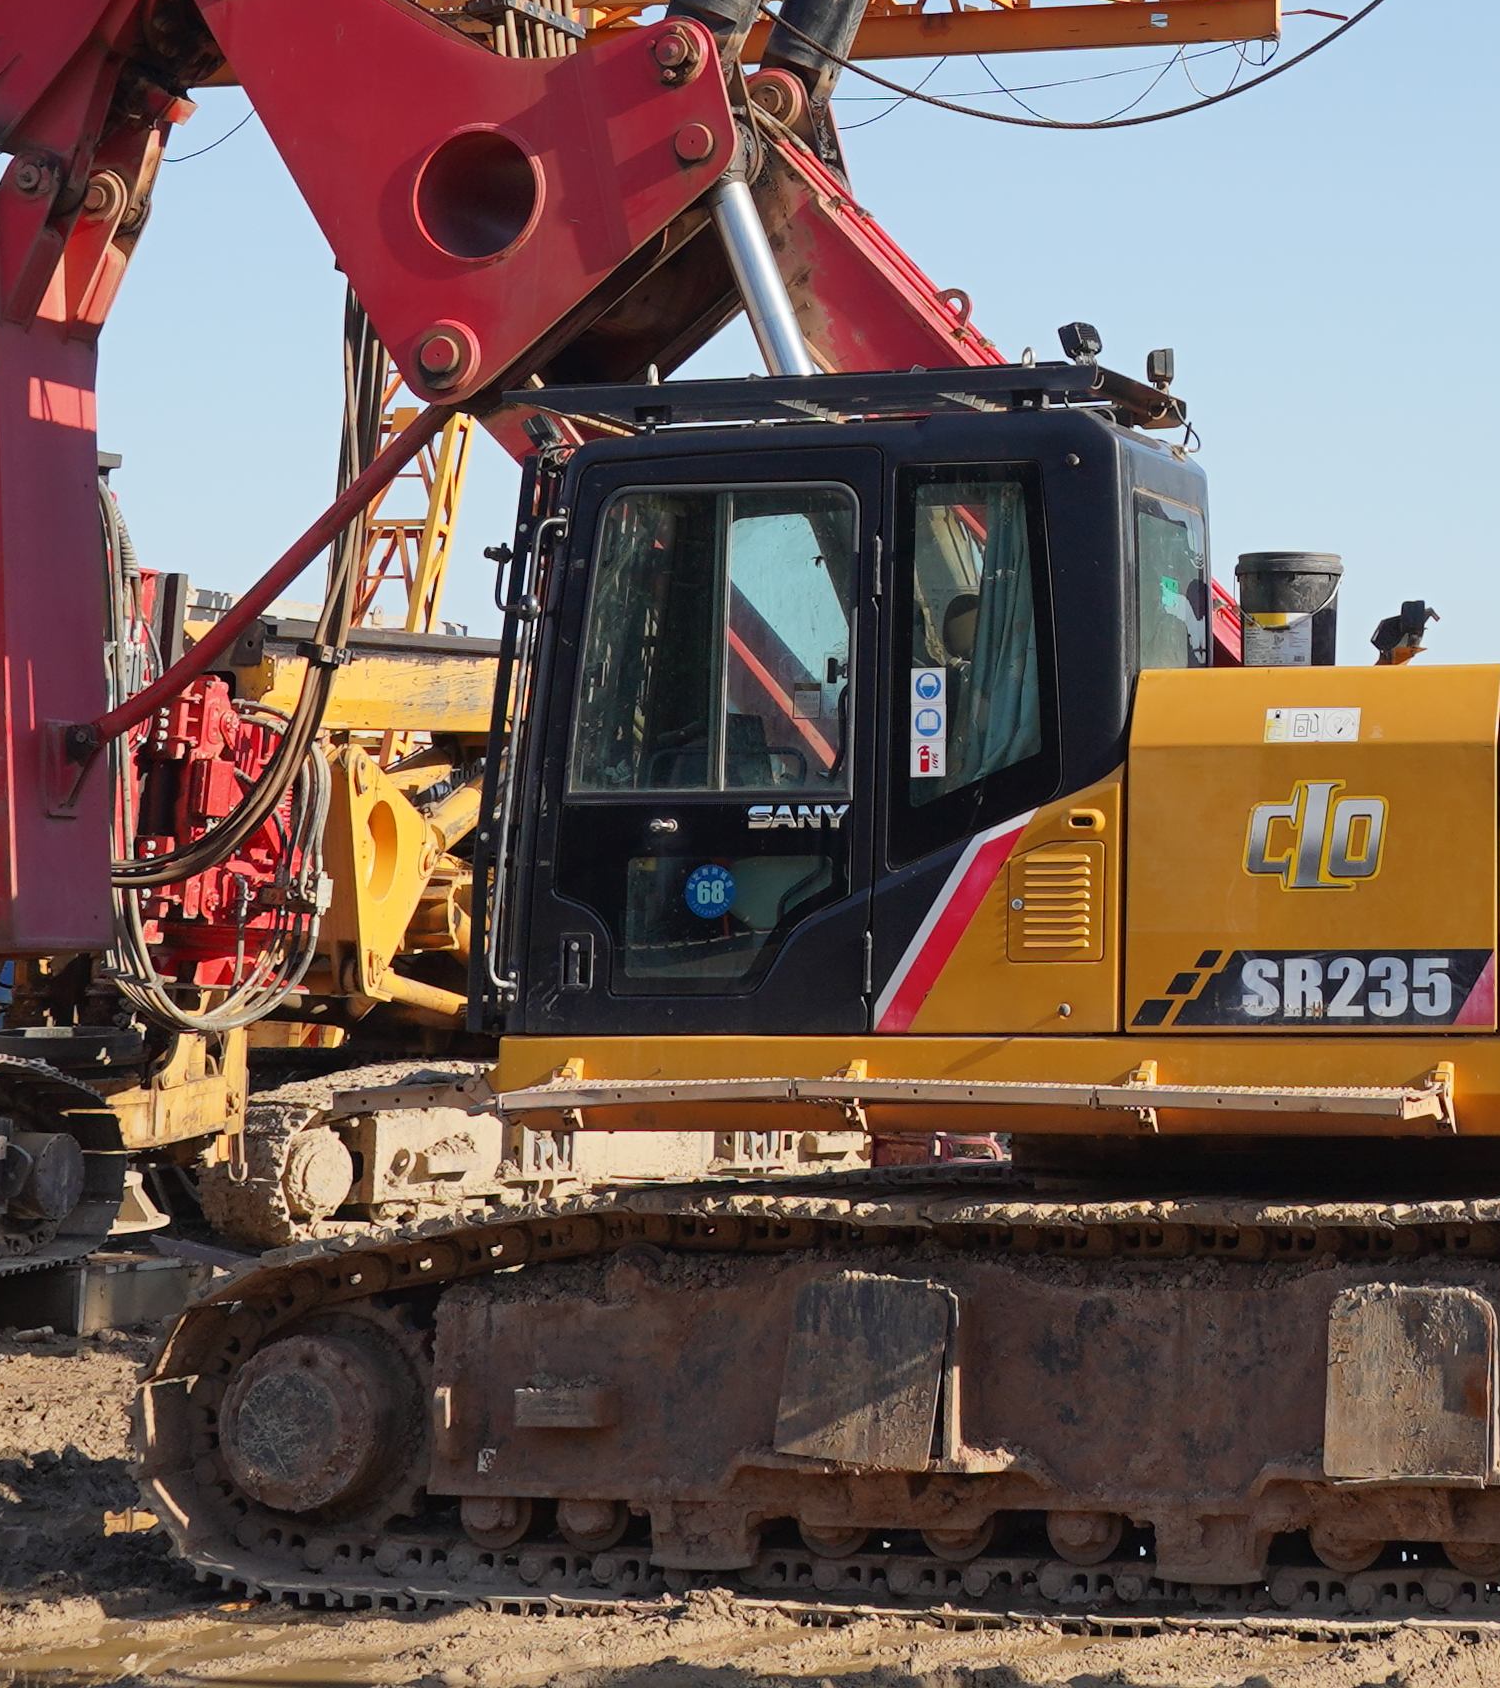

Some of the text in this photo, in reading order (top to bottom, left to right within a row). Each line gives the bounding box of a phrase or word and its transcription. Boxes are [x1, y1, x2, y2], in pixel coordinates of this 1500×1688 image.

[747, 804, 850, 829] SANY
[697, 880, 725, 905] 68
[1241, 956, 1453, 1018] SR235
